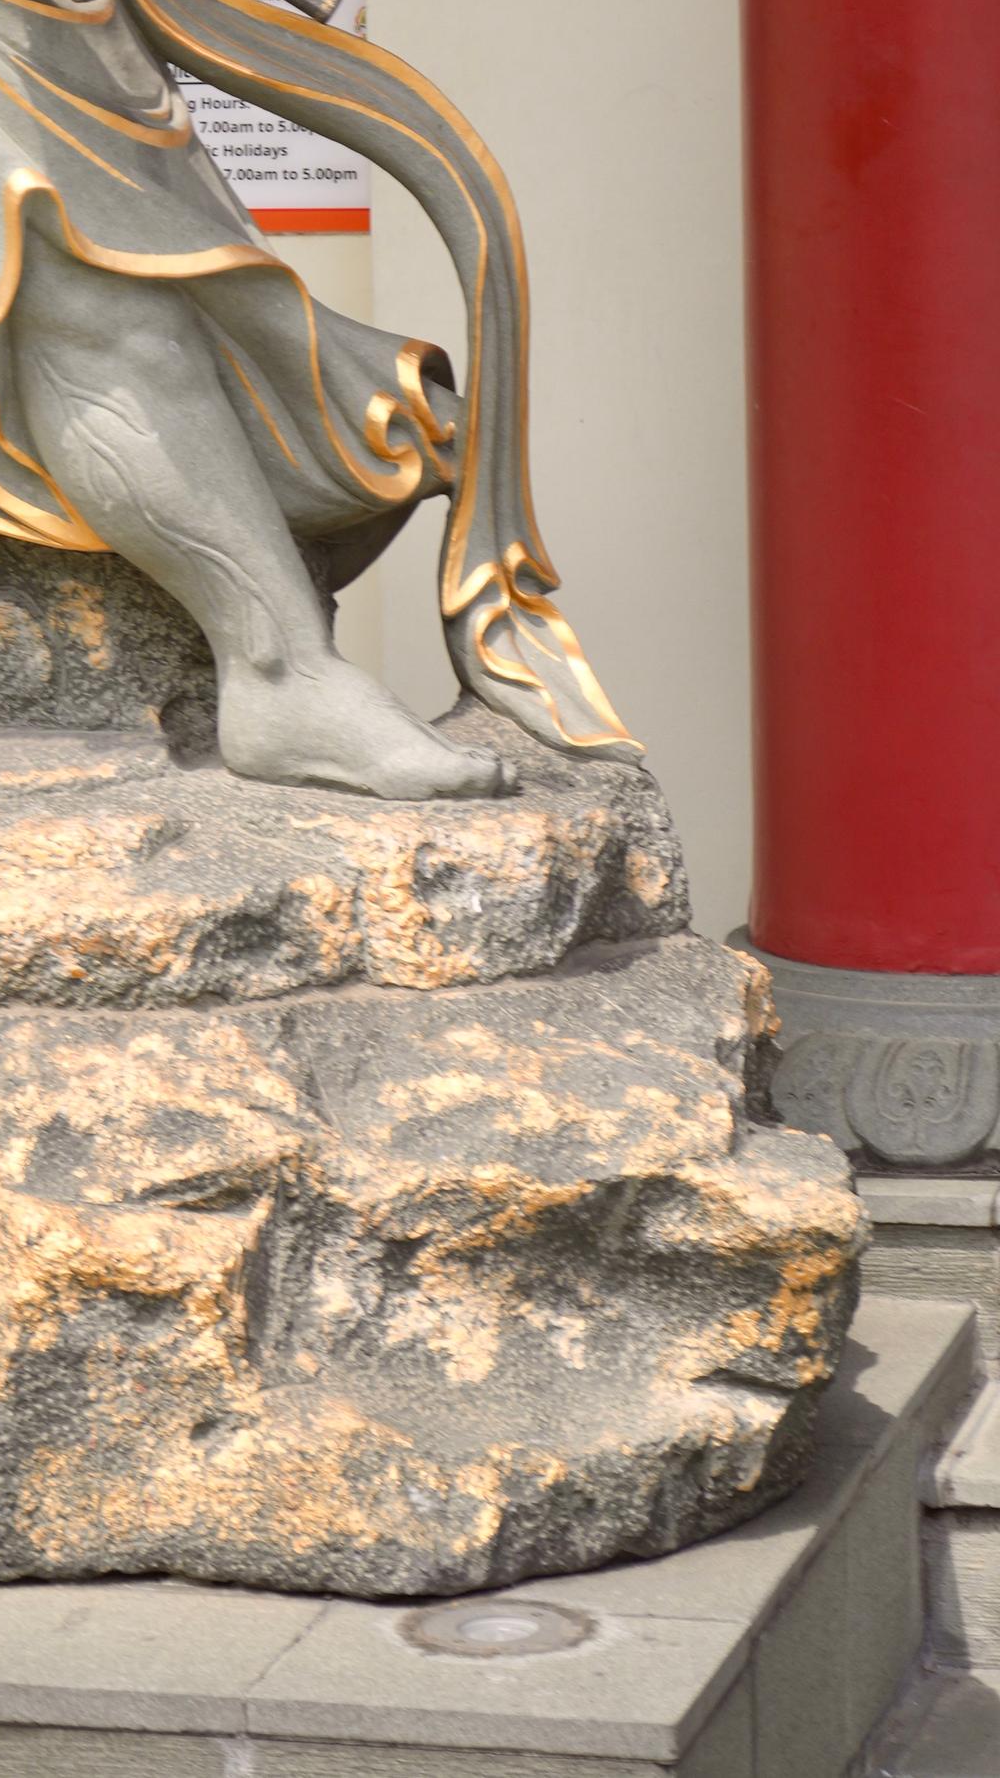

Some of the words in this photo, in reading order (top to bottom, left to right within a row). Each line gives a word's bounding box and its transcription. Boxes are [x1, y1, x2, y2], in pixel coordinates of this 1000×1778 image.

[200, 120, 254, 133] 7.00am
[258, 121, 274, 133] to
[223, 144, 288, 160] Holidays
[223, 168, 278, 181] 7.00am
[283, 169, 298, 181] to
[303, 168, 358, 183] 5.00pm
